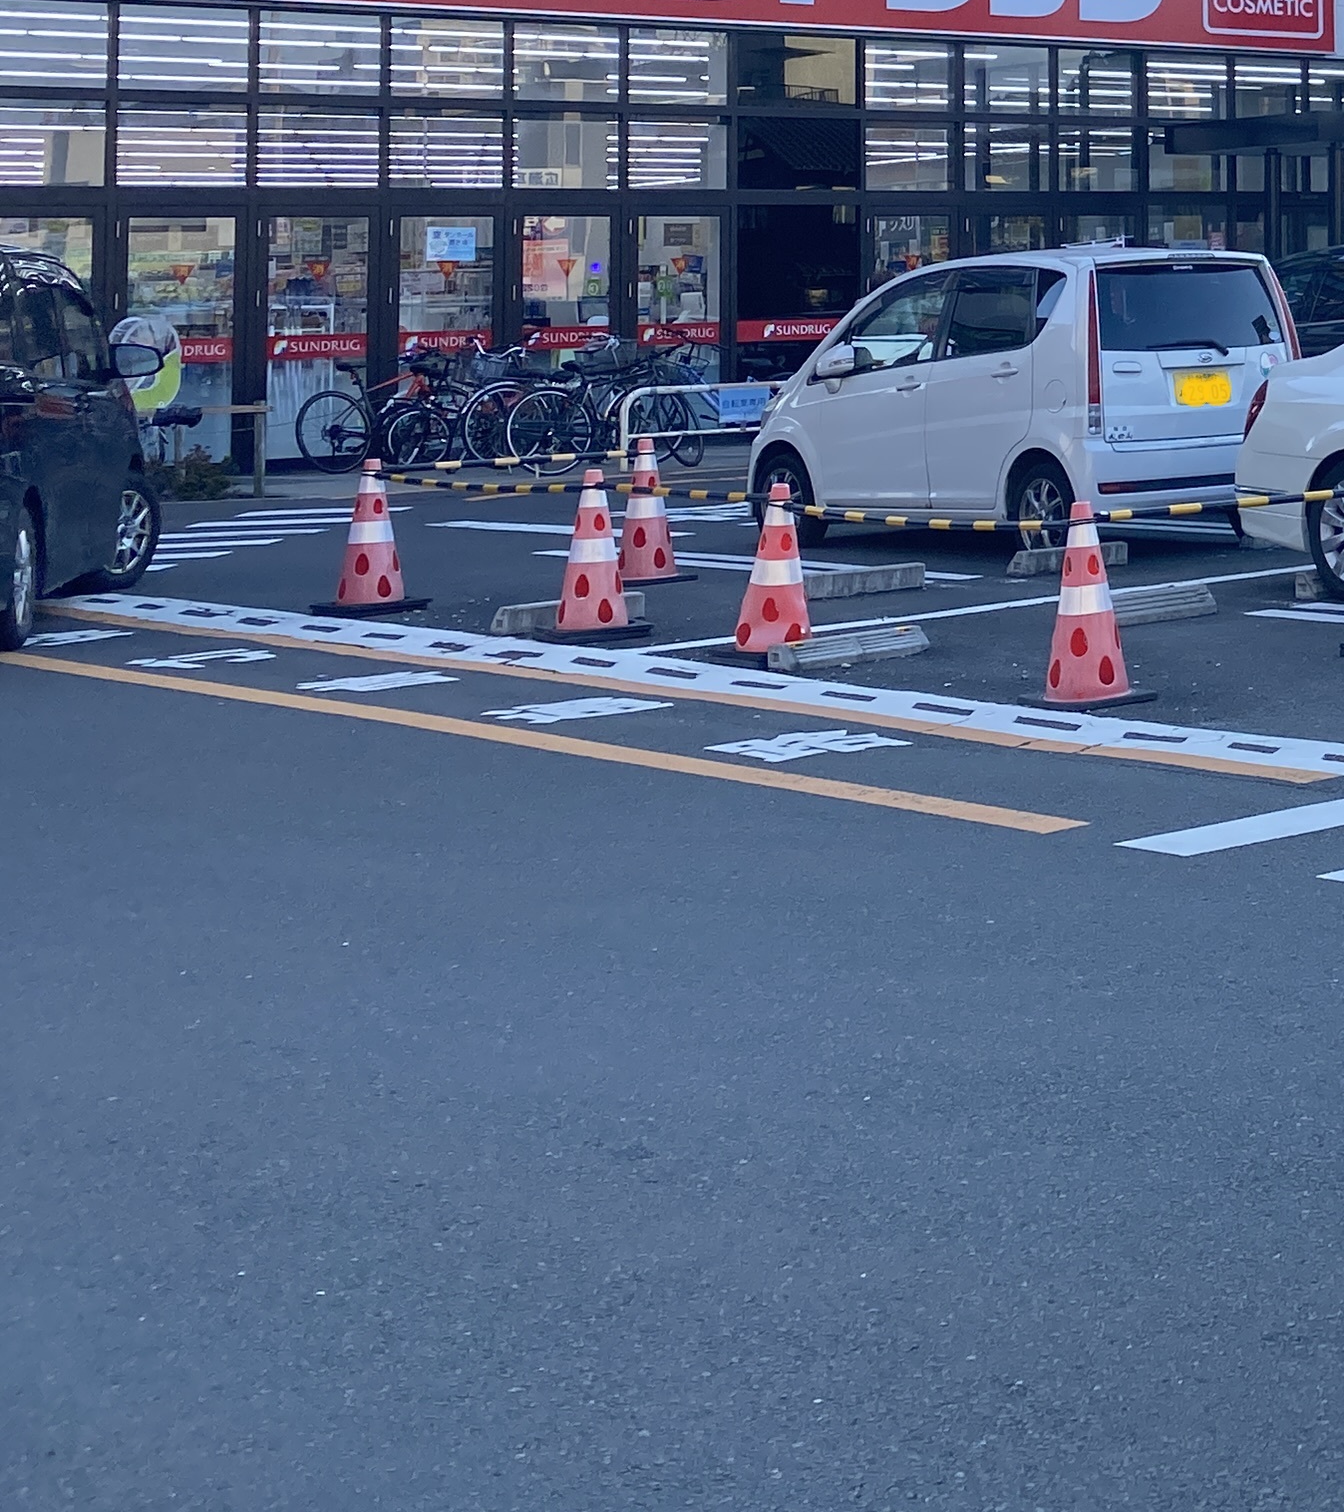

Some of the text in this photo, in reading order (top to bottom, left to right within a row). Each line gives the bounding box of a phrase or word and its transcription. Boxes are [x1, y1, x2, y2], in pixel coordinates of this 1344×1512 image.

[656, 327, 715, 340] SUDRUG
[776, 323, 831, 336] SUNDRUG
[183, 344, 226, 357] DRUG
[289, 338, 361, 353] SUNDRUG
